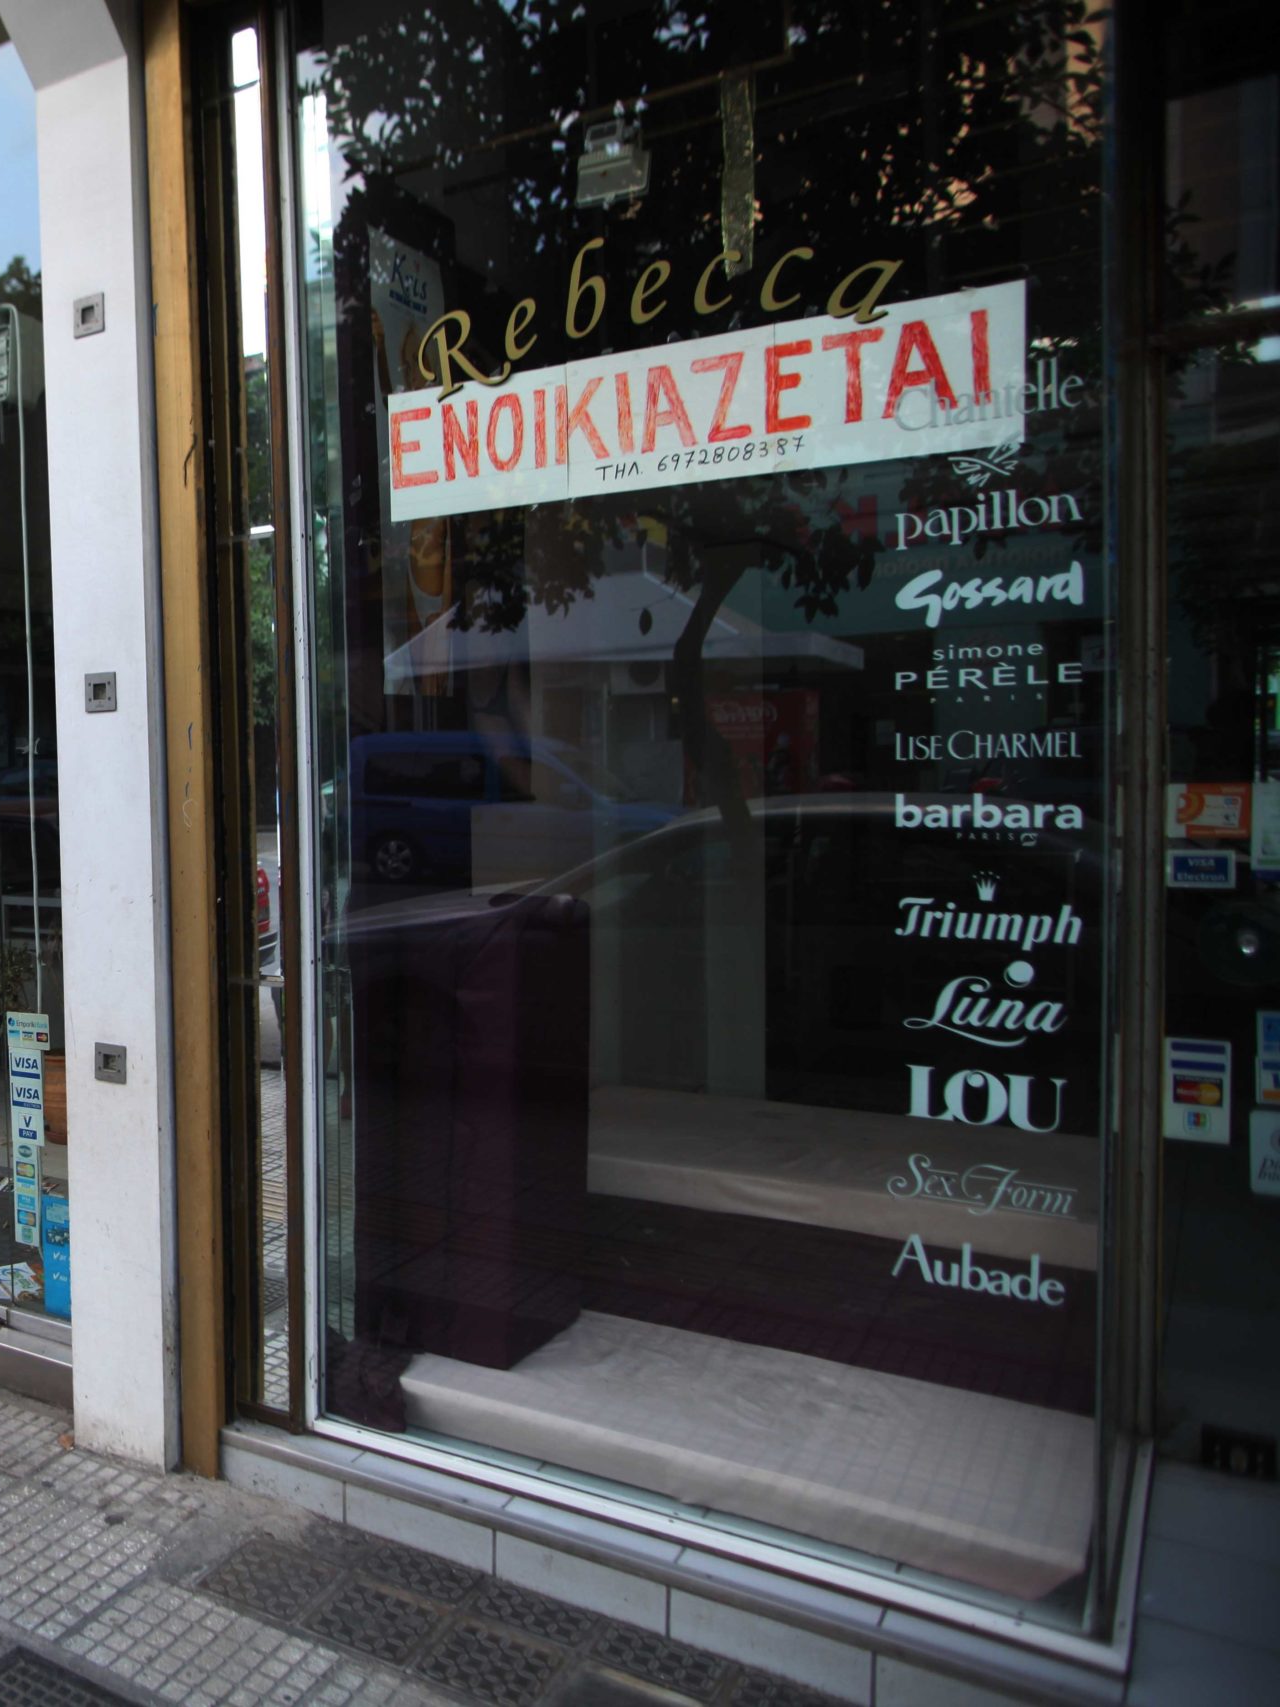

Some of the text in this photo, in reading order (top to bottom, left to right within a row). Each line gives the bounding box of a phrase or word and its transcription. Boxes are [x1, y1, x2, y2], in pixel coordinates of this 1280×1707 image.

[419, 237, 904, 398] Rebecca
[390, 308, 992, 490] ΕΝΟΙΚΙΑΖΕΤΑΙ
[894, 355, 1085, 432] Chantelle
[657, 434, 805, 473] 6972808387
[894, 489, 1084, 551] papillon
[894, 560, 1085, 629] Gossard
[932, 642, 1045, 662] simone
[894, 661, 1084, 691] PÉRÈLE
[930, 692, 1045, 704] PARIS
[947, 729, 1083, 759] CHARMEL
[894, 792, 1084, 829] barbara
[956, 832, 1015, 842] PARIS
[894, 896, 1083, 951] Triumph
[903, 975, 1068, 1048] Luna
[15, 1057, 39, 1070] VISA
[16, 1087, 40, 1101] VISA
[905, 1064, 1067, 1133] LOU
[22, 1130, 34, 1138] PAY
[891, 1233, 1066, 1306] Aubade
